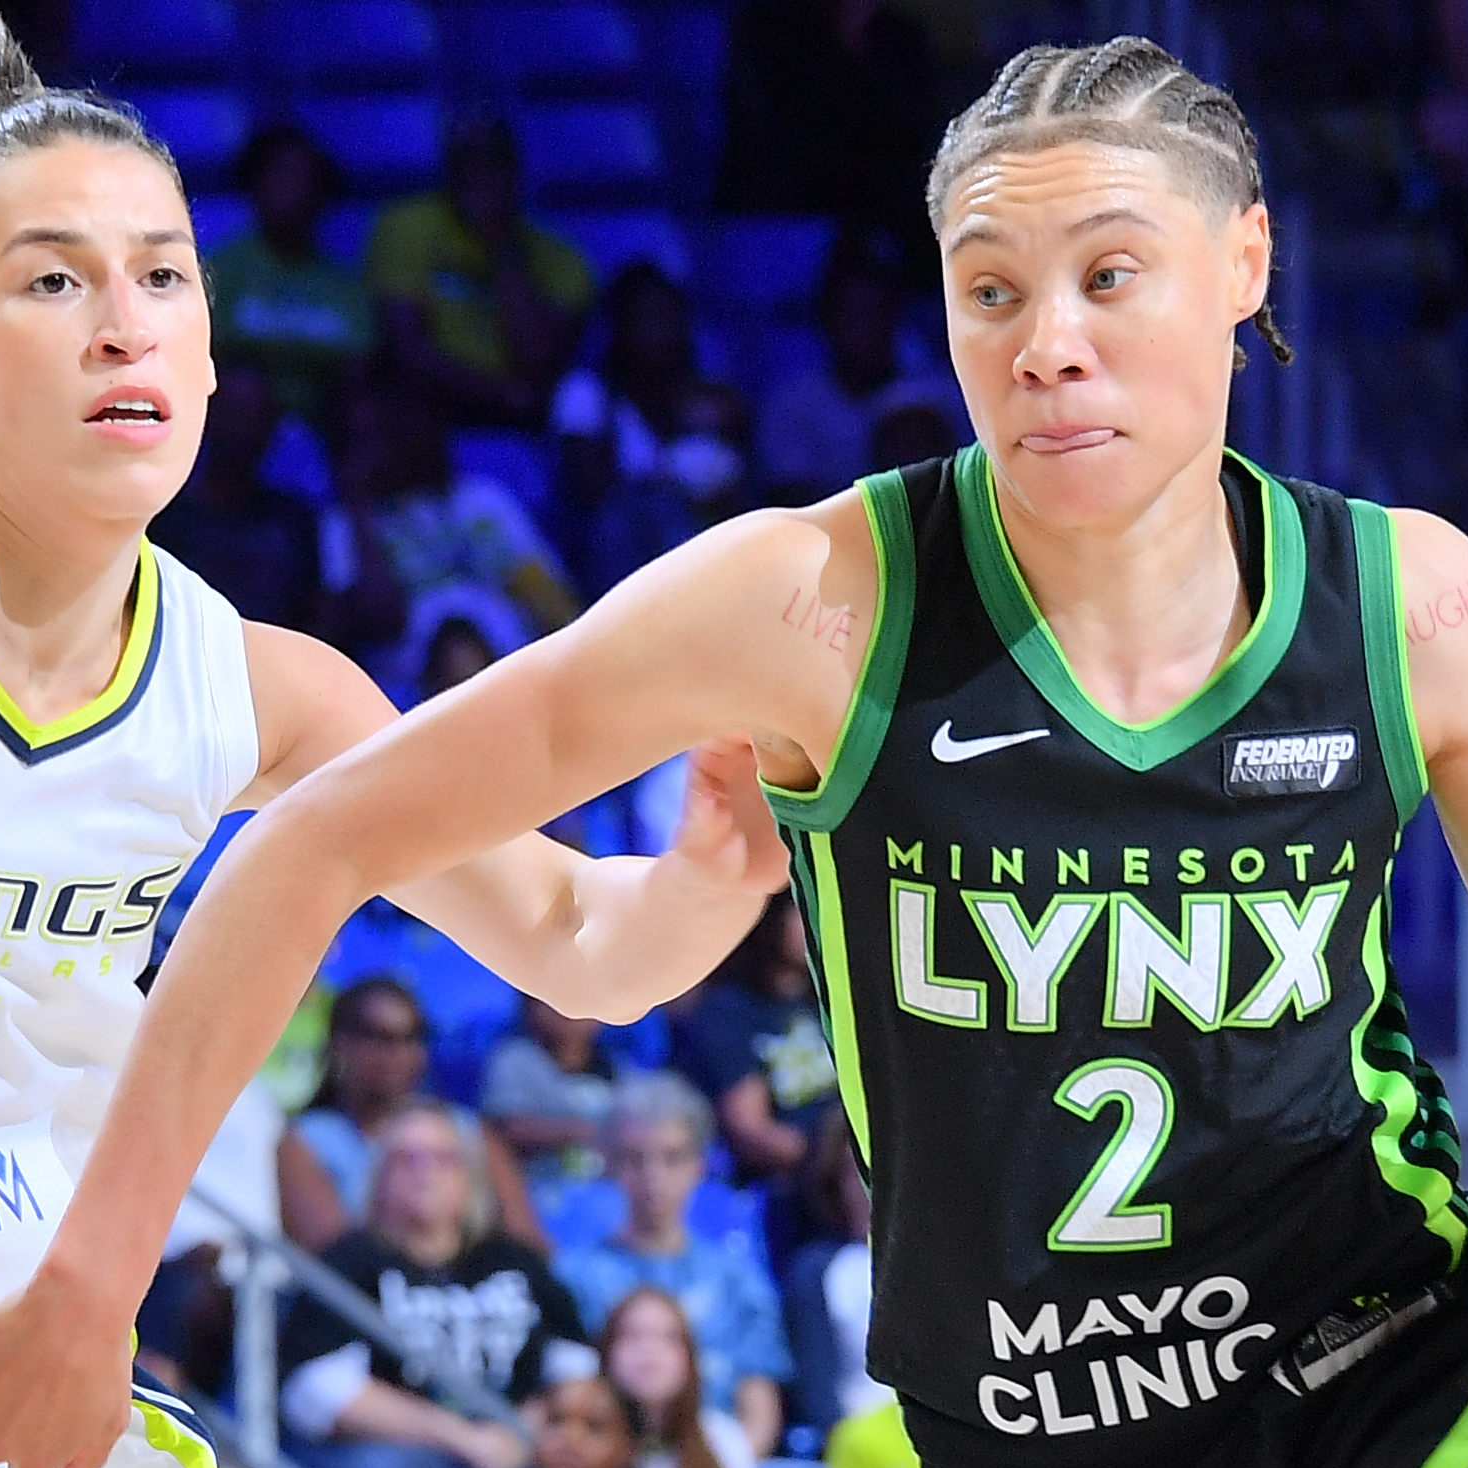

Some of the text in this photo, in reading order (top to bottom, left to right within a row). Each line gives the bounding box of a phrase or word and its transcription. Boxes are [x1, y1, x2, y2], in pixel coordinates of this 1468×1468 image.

[783, 587, 857, 652] LIVE
[1230, 761, 1318, 783] INSURANCE
[1234, 734, 1356, 766] FEDERATED
[886, 835, 1356, 886] MINNESOTA
[889, 878, 1351, 1033] LYNX
[1047, 1057, 1176, 1253] 2
[987, 1275, 1250, 1361] MAYO
[978, 1322, 1277, 1436] CLINIC
